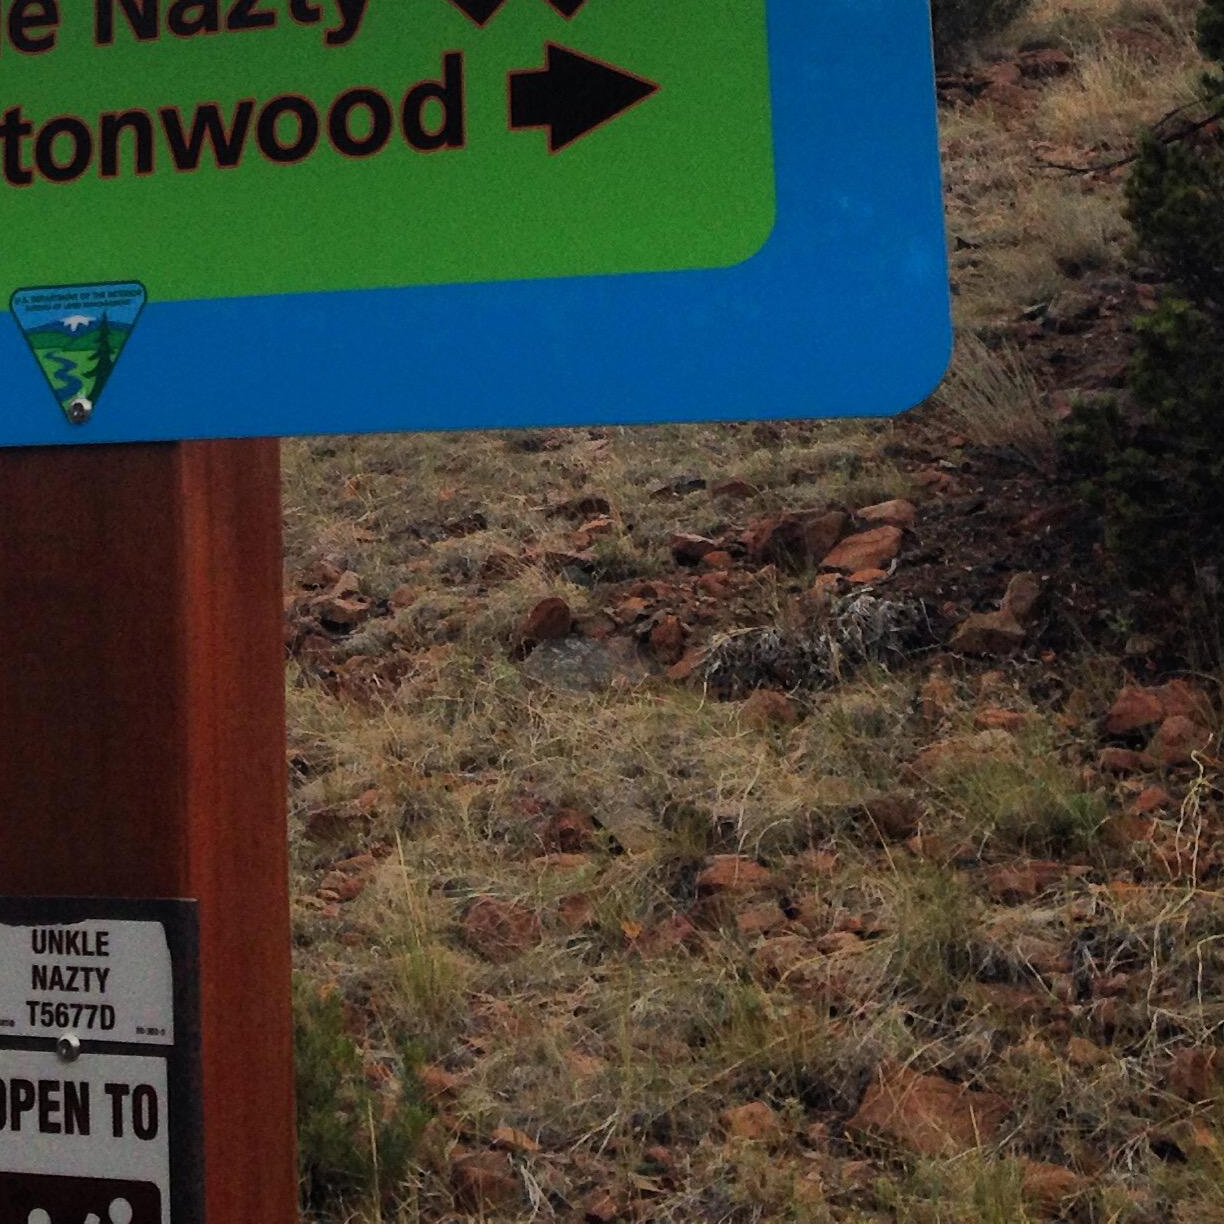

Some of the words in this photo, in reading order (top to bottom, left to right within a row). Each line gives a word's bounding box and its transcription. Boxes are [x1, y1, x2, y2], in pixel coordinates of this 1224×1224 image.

[31, 929, 109, 957] UNKLE
[31, 964, 110, 994] NAZTY
[26, 1000, 116, 1031] T5677D
[104, 1082, 159, 1141] TO
